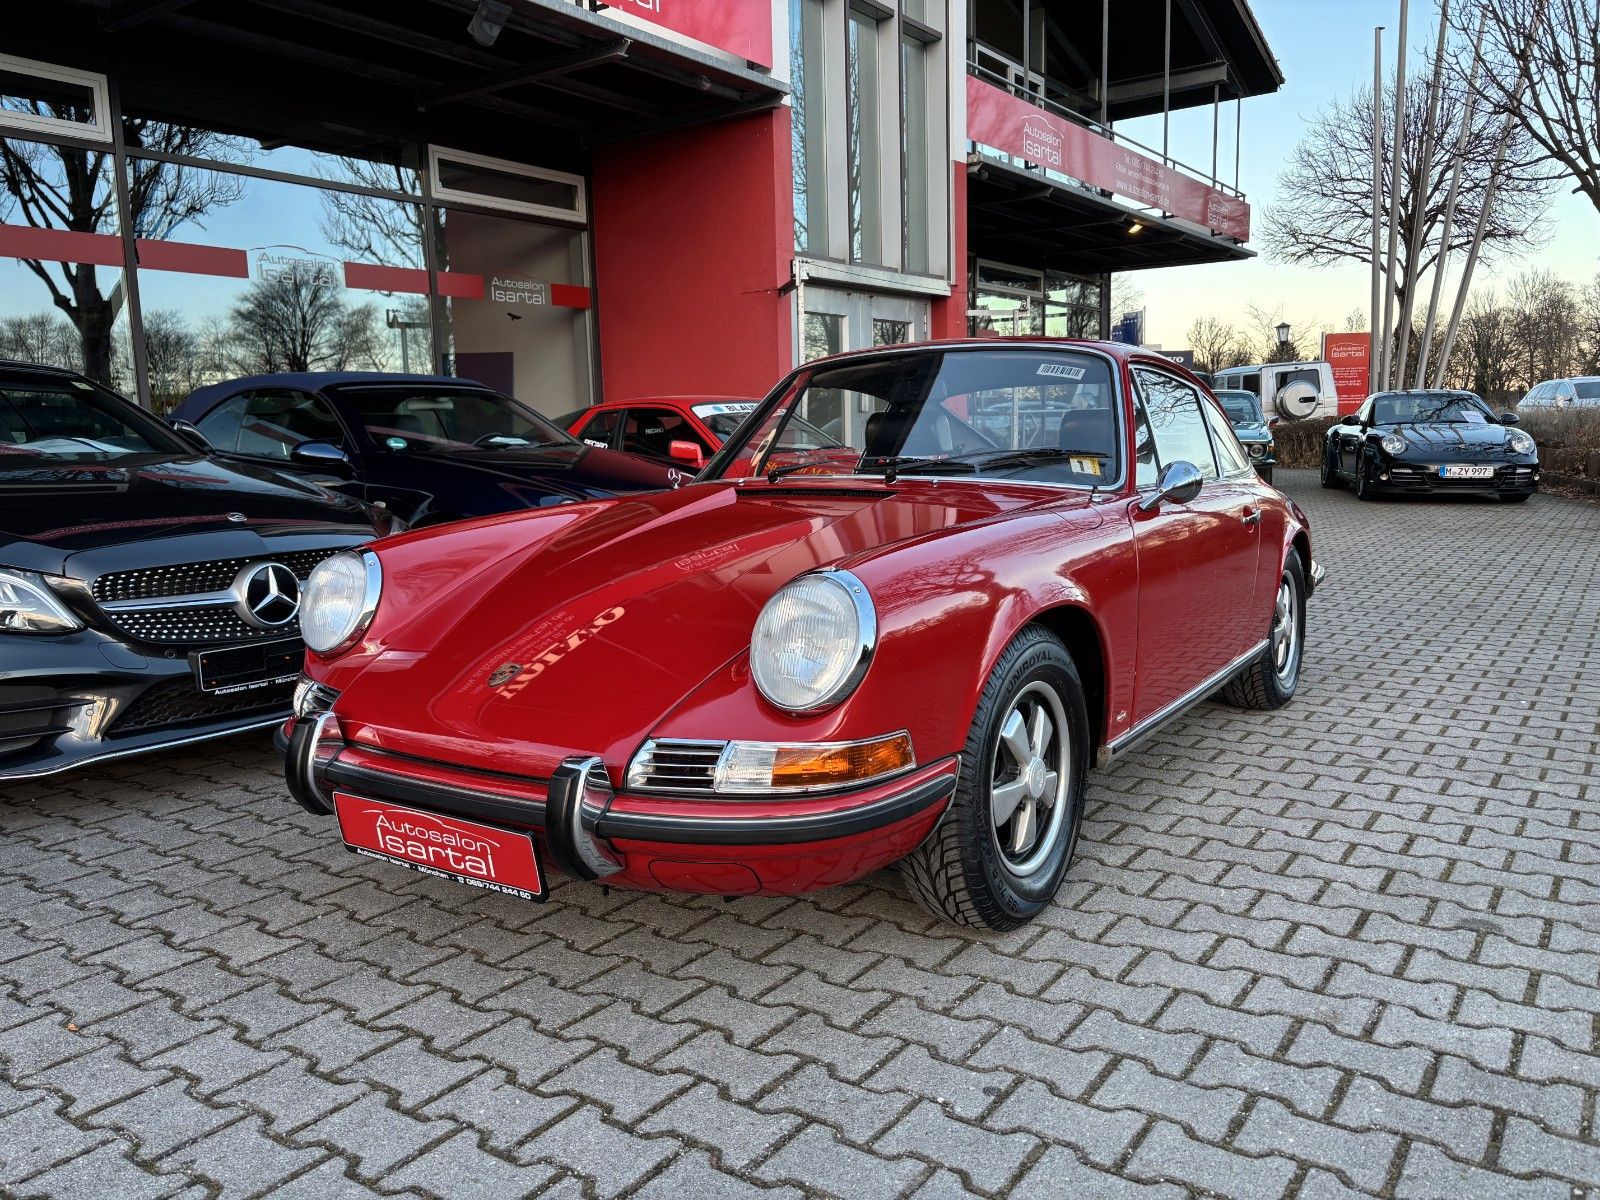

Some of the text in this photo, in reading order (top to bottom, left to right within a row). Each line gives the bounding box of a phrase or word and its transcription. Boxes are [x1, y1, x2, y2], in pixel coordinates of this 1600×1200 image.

[1023, 121, 1062, 148] Autosalon
[1023, 133, 1062, 166] Isartal
[257, 252, 334, 270] Autosalon
[491, 276, 545, 291] Autosalon
[491, 286, 545, 305] Isartal
[1445, 467, 1452, 476] M
[1457, 467, 1470, 476] ZY
[1471, 467, 1488, 476] 997
[1006, 649, 1053, 694] UNIROYAL
[214, 684, 247, 695] Autosalon
[248, 681, 268, 690] Isartal
[375, 814, 492, 856] Autosalon
[357, 848, 389, 862] Autosalon
[418, 865, 450, 879] München
[376, 826, 496, 877] Isartal
